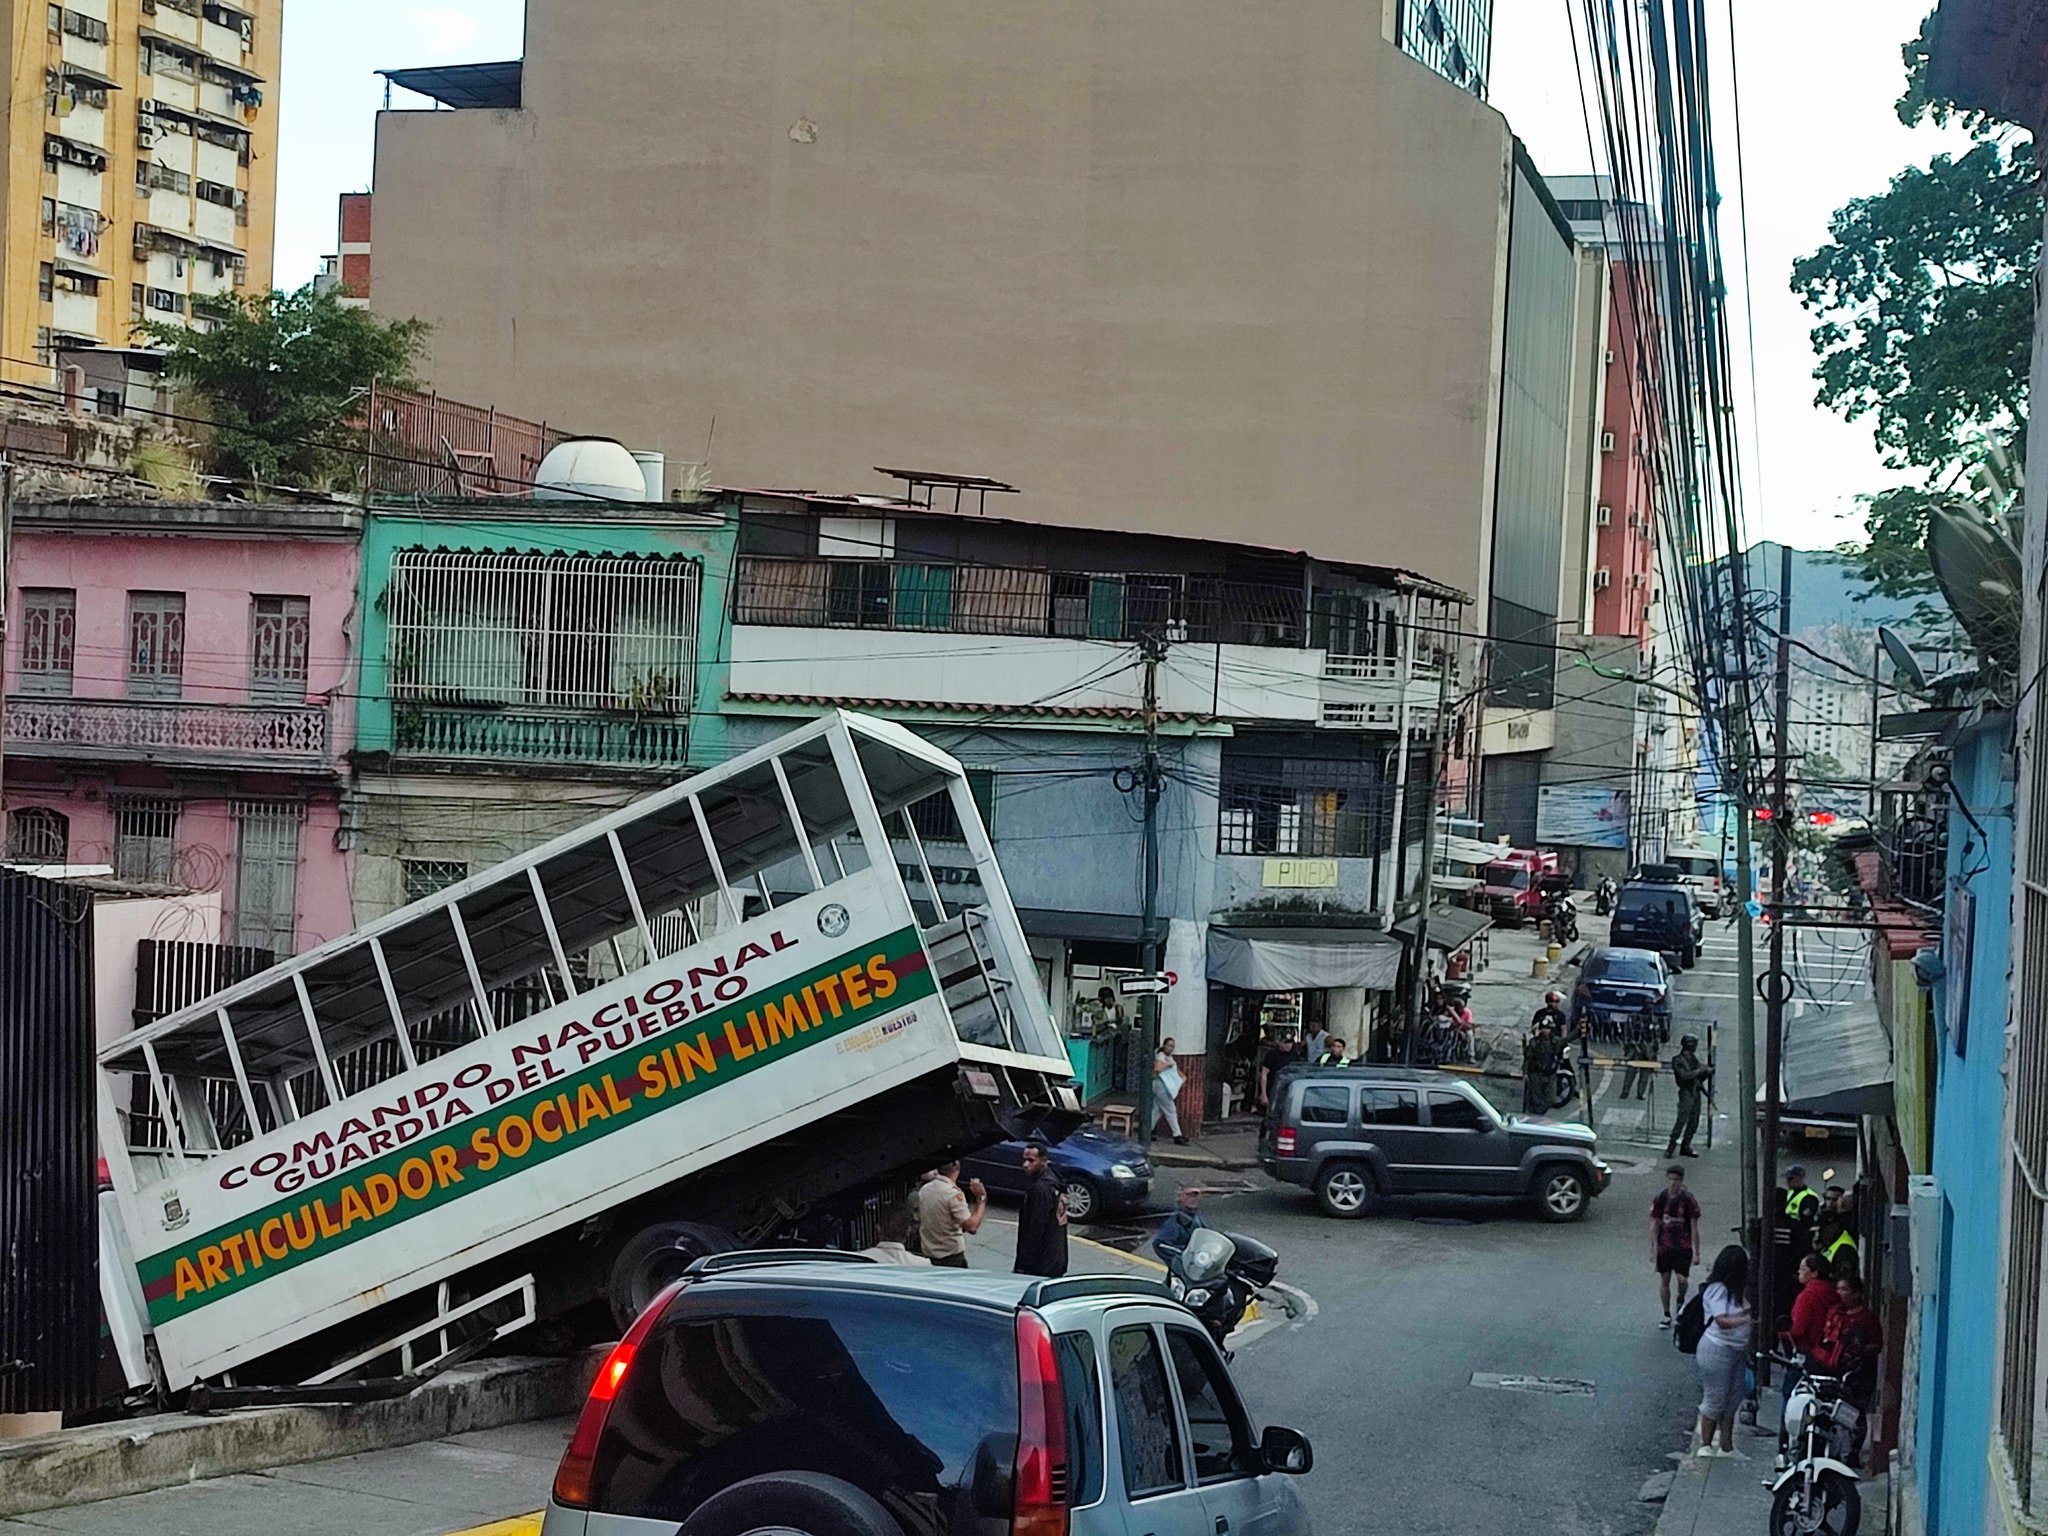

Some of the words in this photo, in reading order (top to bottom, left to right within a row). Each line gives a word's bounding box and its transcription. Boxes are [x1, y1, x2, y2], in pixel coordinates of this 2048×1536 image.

[1278, 862, 1335, 885] PINEDA
[176, 1146, 463, 1301] ARTICULADOR
[471, 1076, 631, 1169] SOCIAL
[638, 1034, 717, 1098] SIN
[724, 954, 897, 1060] LIMITES
[219, 1063, 492, 1191] COMANDO
[512, 931, 799, 1066] NACIONAL
[274, 1098, 473, 1194] GUARDIA
[485, 1059, 566, 1104] DEL
[578, 975, 748, 1065] PUEBLO
